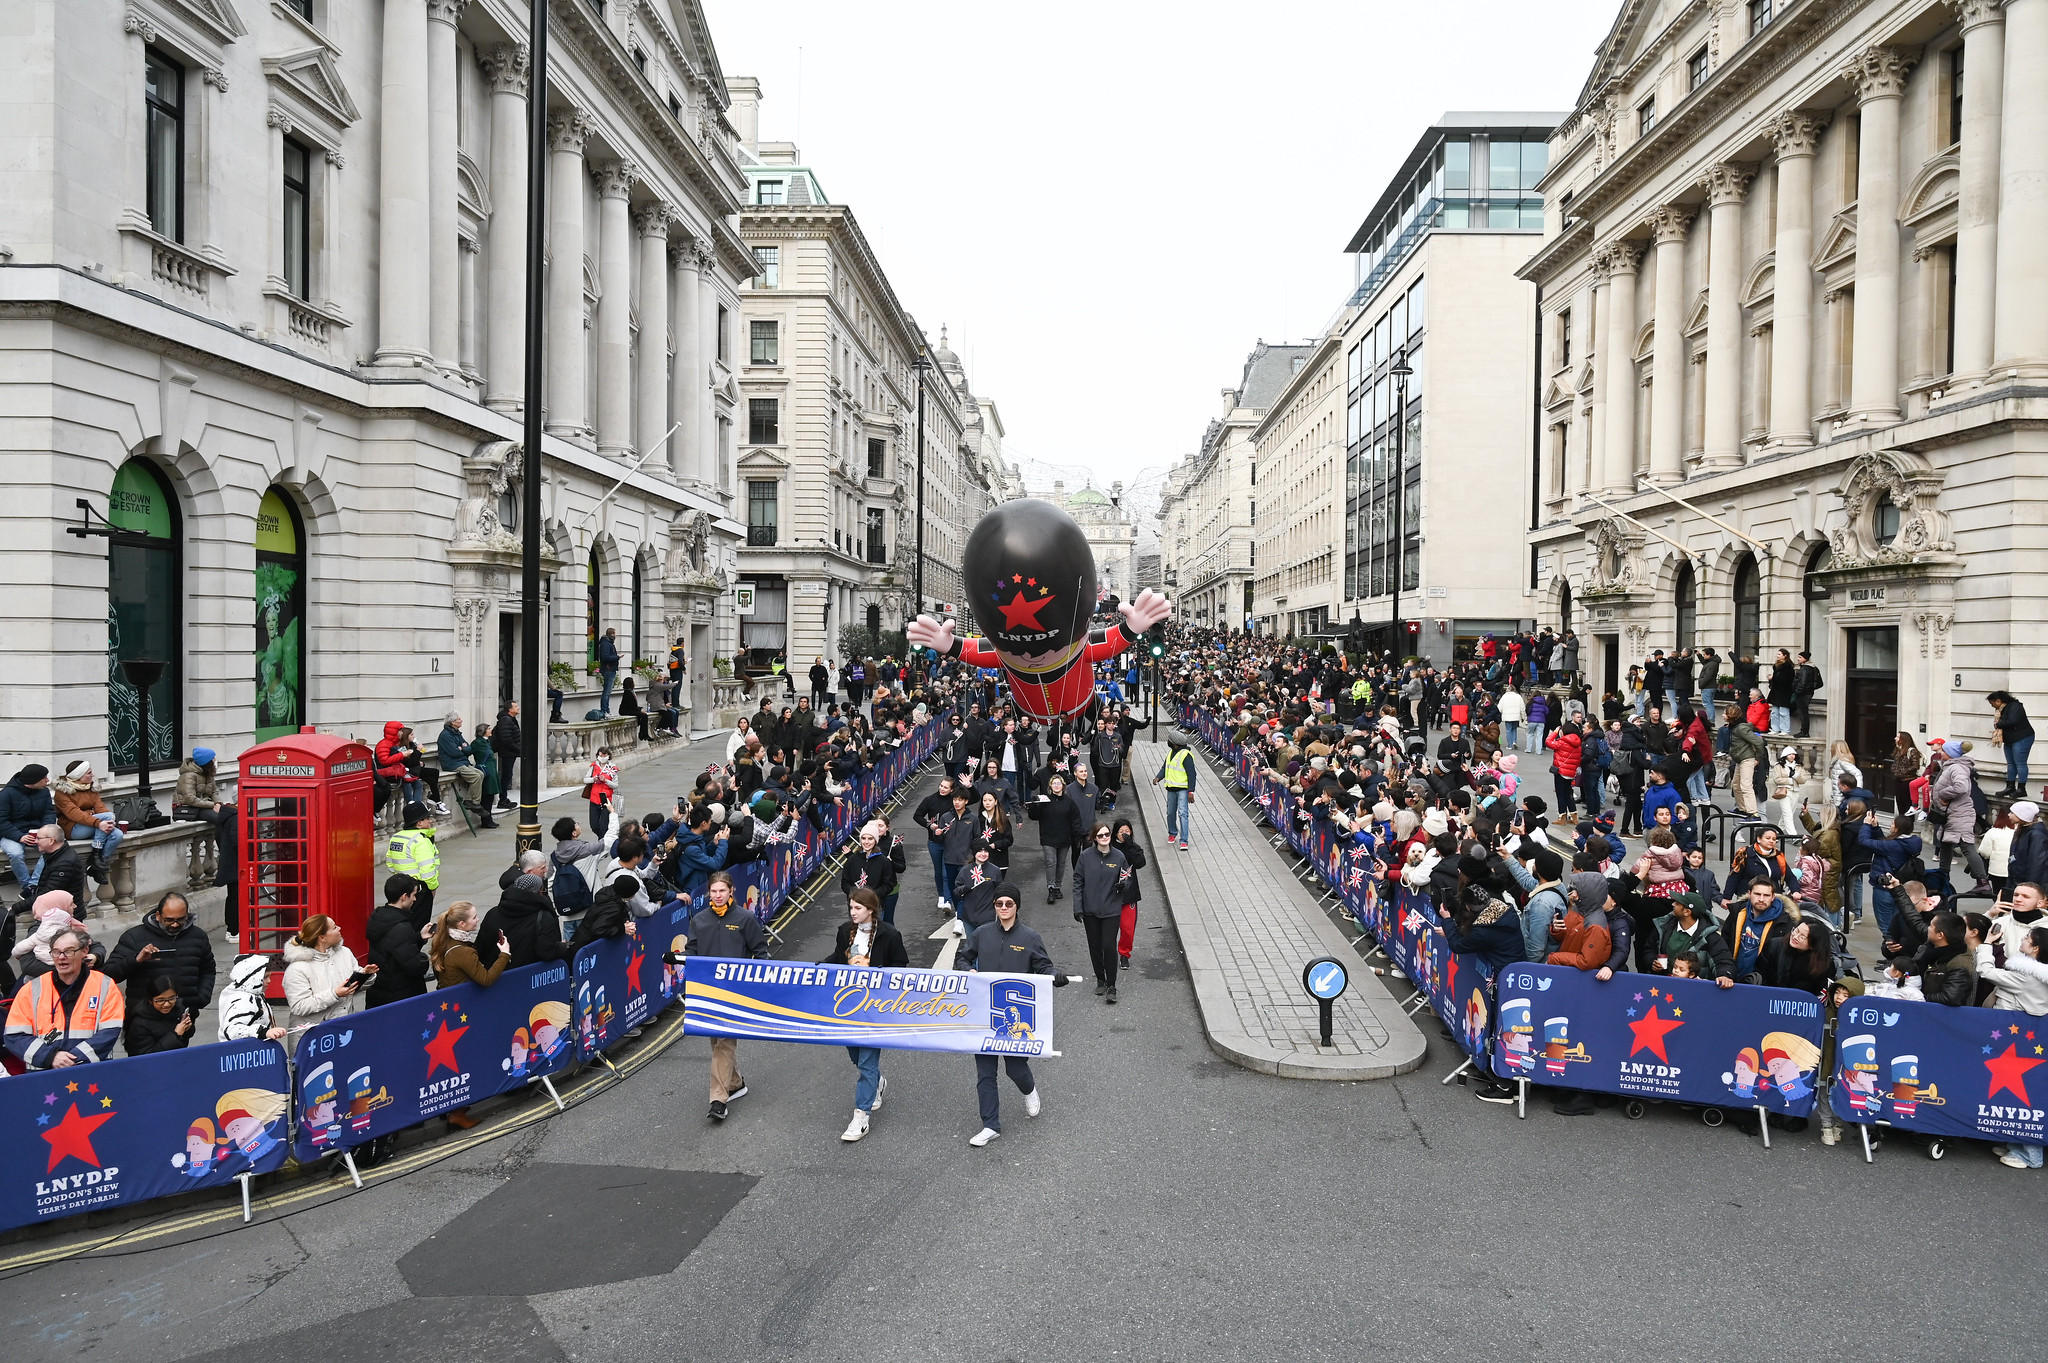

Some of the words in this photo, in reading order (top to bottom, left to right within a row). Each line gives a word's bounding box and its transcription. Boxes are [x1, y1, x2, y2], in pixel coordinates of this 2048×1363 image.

[120, 491, 151, 504] CROWN
[120, 503, 151, 515] ESTATE
[257, 523, 279, 533] ESTATE
[998, 629, 1060, 641] LNYDP
[432, 657, 439, 672] 12
[1954, 673, 1962, 687] 8
[252, 765, 313, 775] TELEPHONE
[331, 760, 366, 775] TELEPHONE
[531, 966, 566, 989] LNYDP.COM
[714, 963, 828, 986] STILLWATER
[834, 969, 884, 989] HIGH
[888, 972, 969, 994] SCHOOL
[625, 993, 647, 1015] LNYDP
[833, 983, 972, 1017] Orchestra
[1769, 999, 1818, 1018] LNYDP.COM
[982, 1038, 1043, 1055] PIONEERS
[220, 1048, 276, 1073] LNYDP.COM
[1620, 1061, 1681, 1078] LNYDP
[420, 1072, 471, 1099] LNYDP
[1620, 1075, 1660, 1085] LONDON'S
[1662, 1079, 1680, 1087] NEW
[420, 1091, 454, 1108] LONDON'S
[455, 1085, 471, 1096] NEW
[1655, 1087, 1680, 1095] PARADE
[1978, 1104, 2045, 1122] LNYDP
[1977, 1118, 2022, 1129] LONDON'S
[2024, 1123, 2044, 1131] NEW
[36, 1167, 119, 1196] LNYDP
[36, 1188, 92, 1207] LONDON'S
[95, 1182, 119, 1194] NEW
[37, 1203, 67, 1216] YEAR'S
[68, 1199, 86, 1209] DAY
[87, 1192, 120, 1205] PARADE
